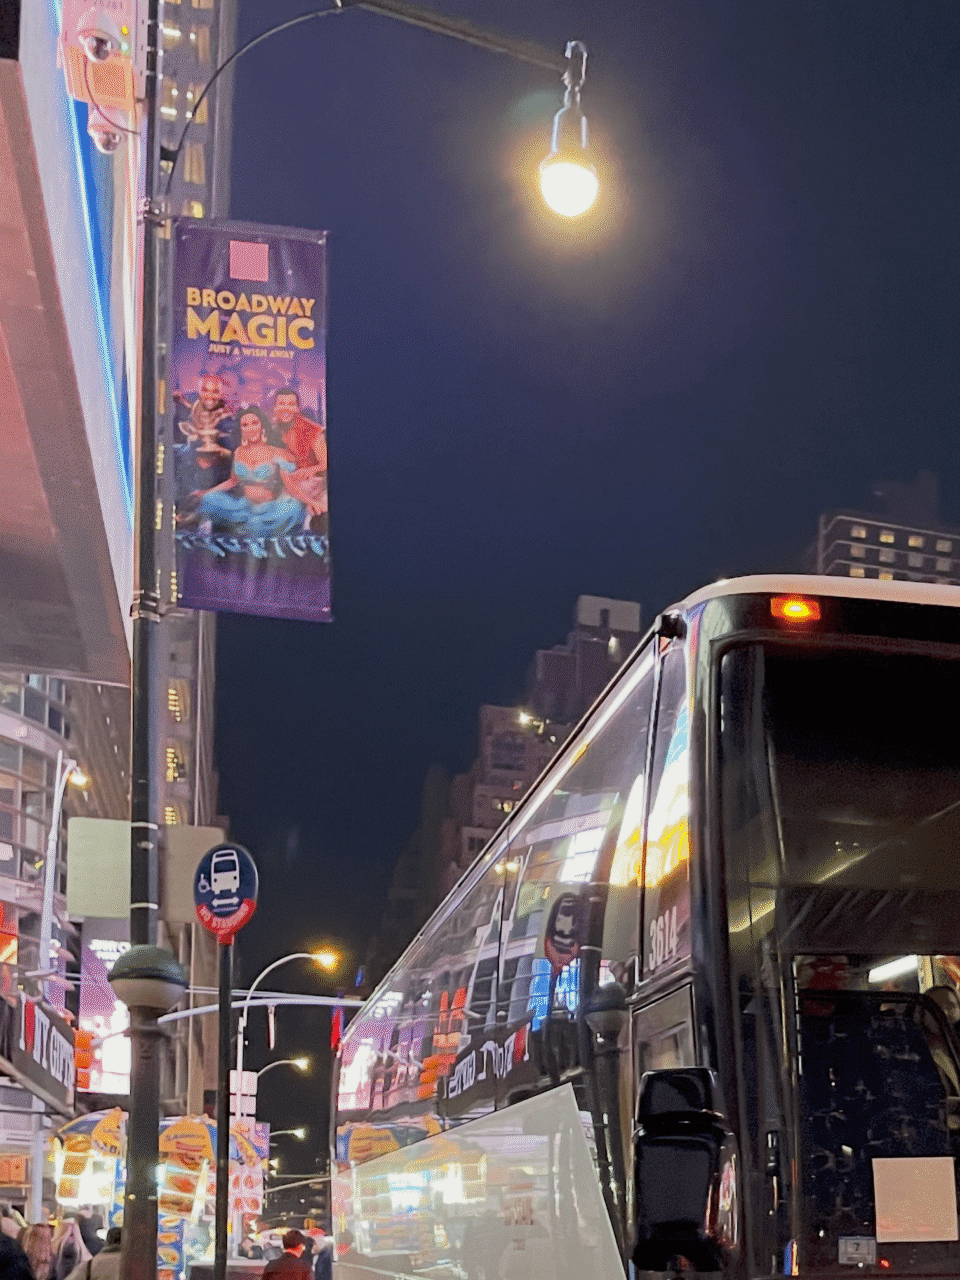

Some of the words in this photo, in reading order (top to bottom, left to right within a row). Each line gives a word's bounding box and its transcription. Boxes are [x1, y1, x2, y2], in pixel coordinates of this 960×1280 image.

[186, 286, 316, 317] BROADWAY
[186, 307, 315, 349] MAGIC
[208, 343, 231, 354] JUST
[233, 347, 240, 355] A
[243, 348, 268, 358] WISH
[269, 350, 295, 360] AWAY
[649, 905, 680, 971] 3614
